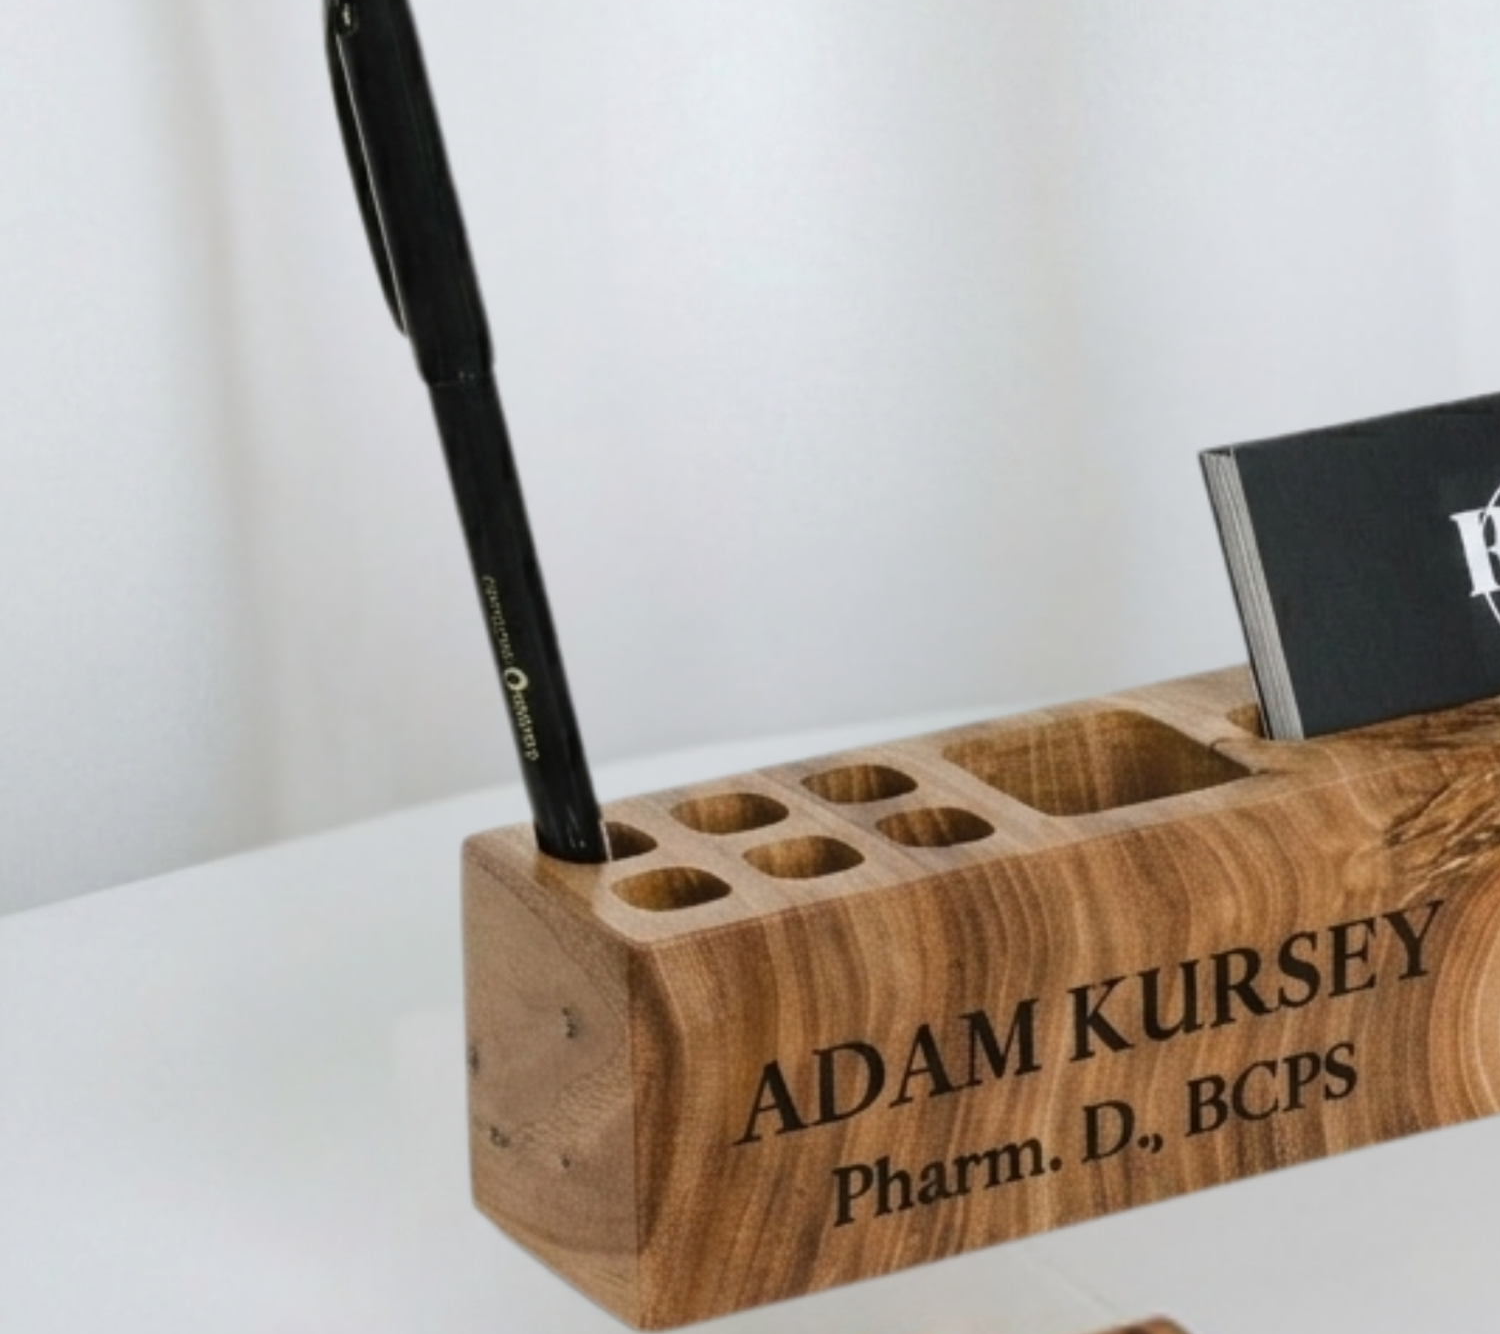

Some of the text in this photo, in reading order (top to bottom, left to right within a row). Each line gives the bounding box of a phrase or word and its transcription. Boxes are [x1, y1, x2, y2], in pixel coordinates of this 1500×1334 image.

[731, 899, 1446, 1147] ADAM KURSEY
[830, 1041, 1360, 1229] Pharm. D., BCPS
